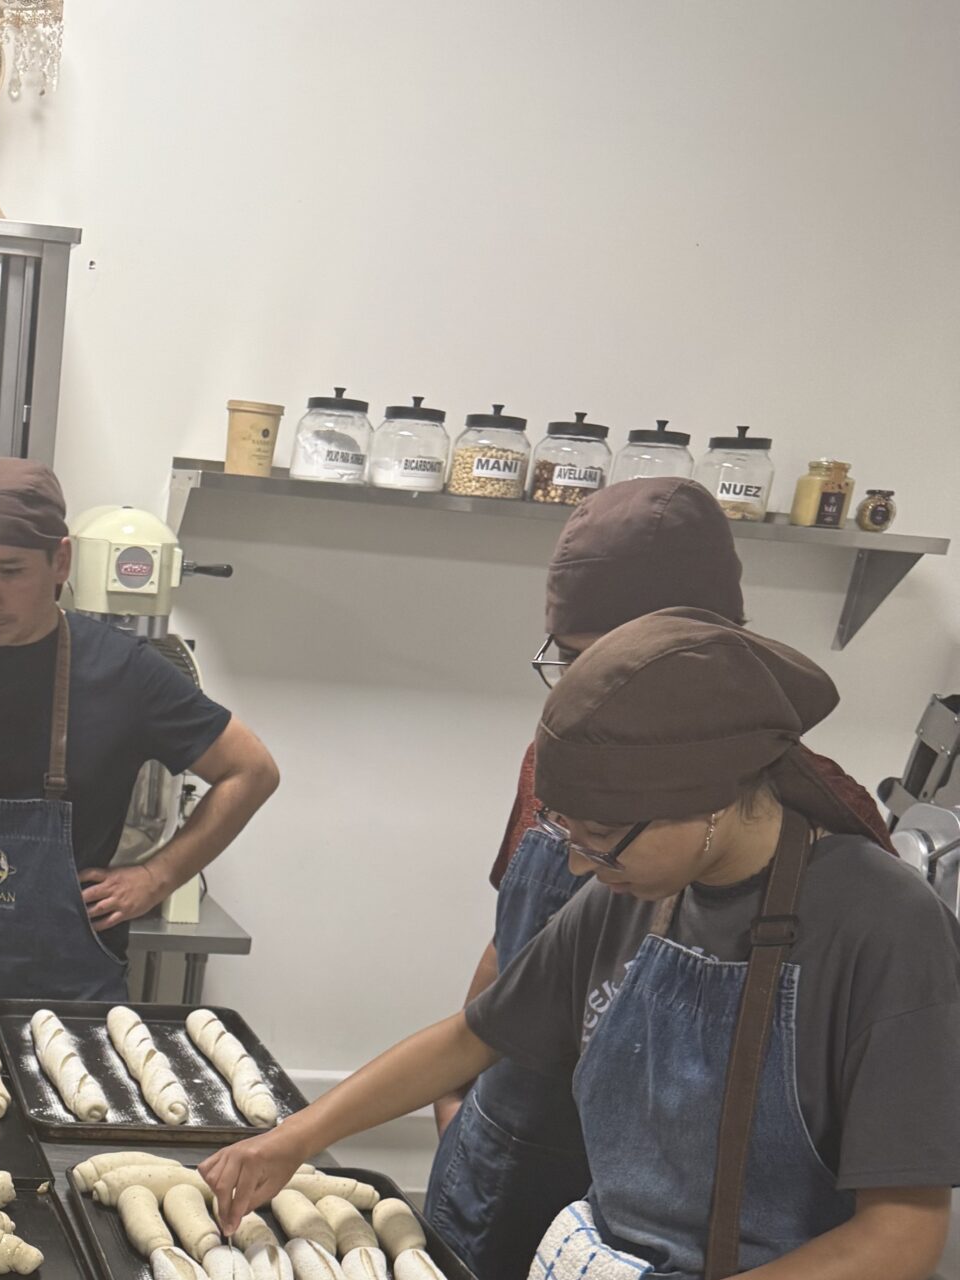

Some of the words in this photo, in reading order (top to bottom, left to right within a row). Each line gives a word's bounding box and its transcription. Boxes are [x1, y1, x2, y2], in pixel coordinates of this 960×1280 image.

[475, 458, 518, 473] MANI
[557, 468, 598, 482] AVELLANA
[719, 482, 762, 498] NUEZ
